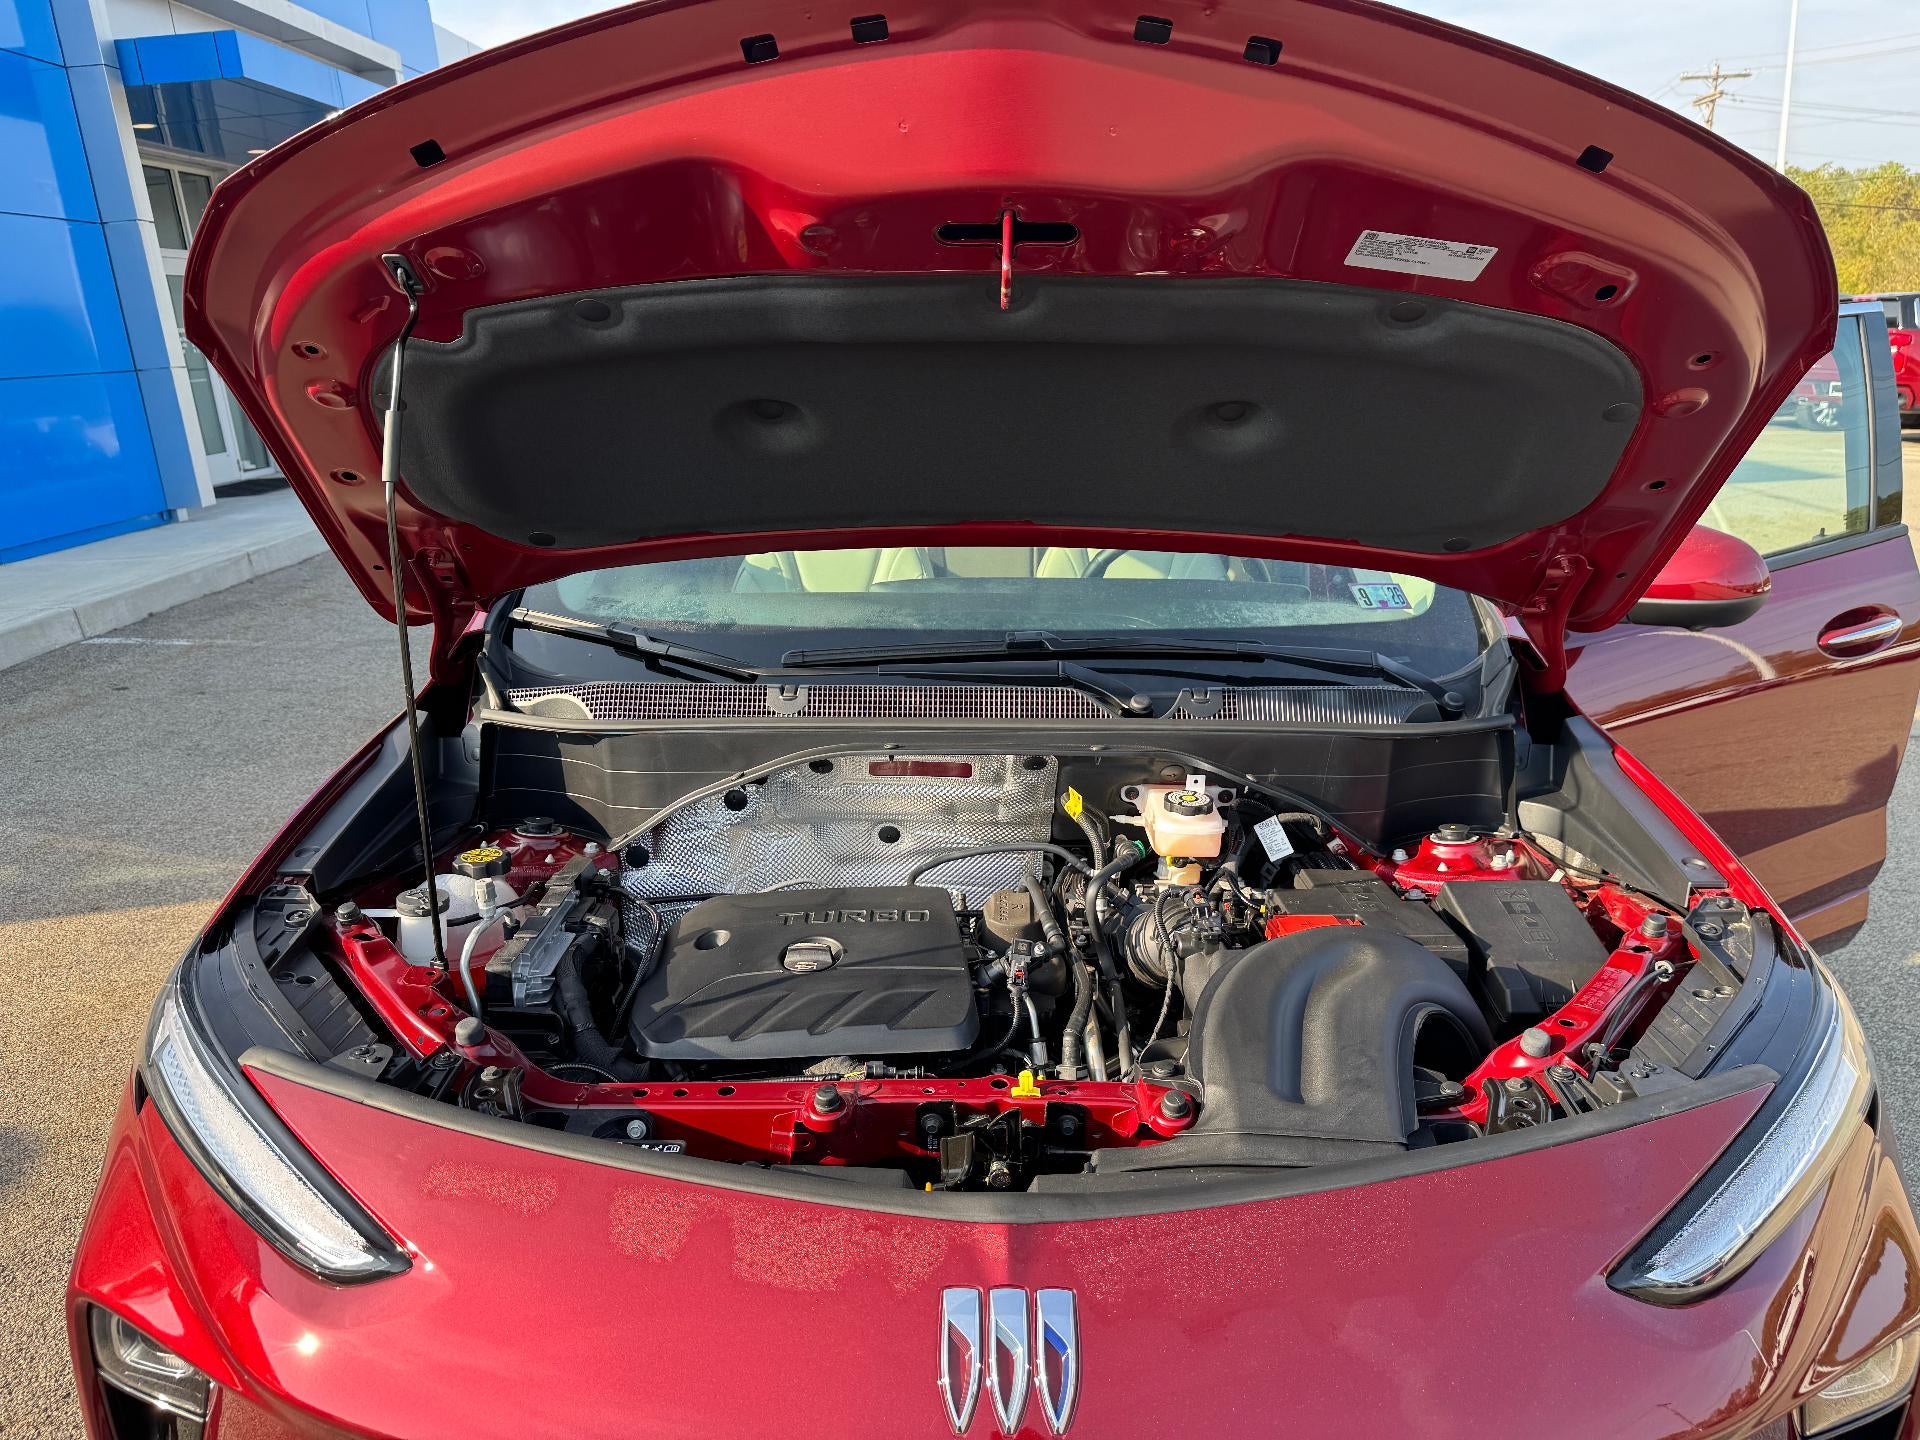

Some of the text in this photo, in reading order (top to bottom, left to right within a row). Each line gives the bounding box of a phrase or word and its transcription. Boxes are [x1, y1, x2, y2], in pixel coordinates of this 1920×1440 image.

[1358, 587, 1406, 606] 9 26
[776, 909, 930, 926] TURBO
